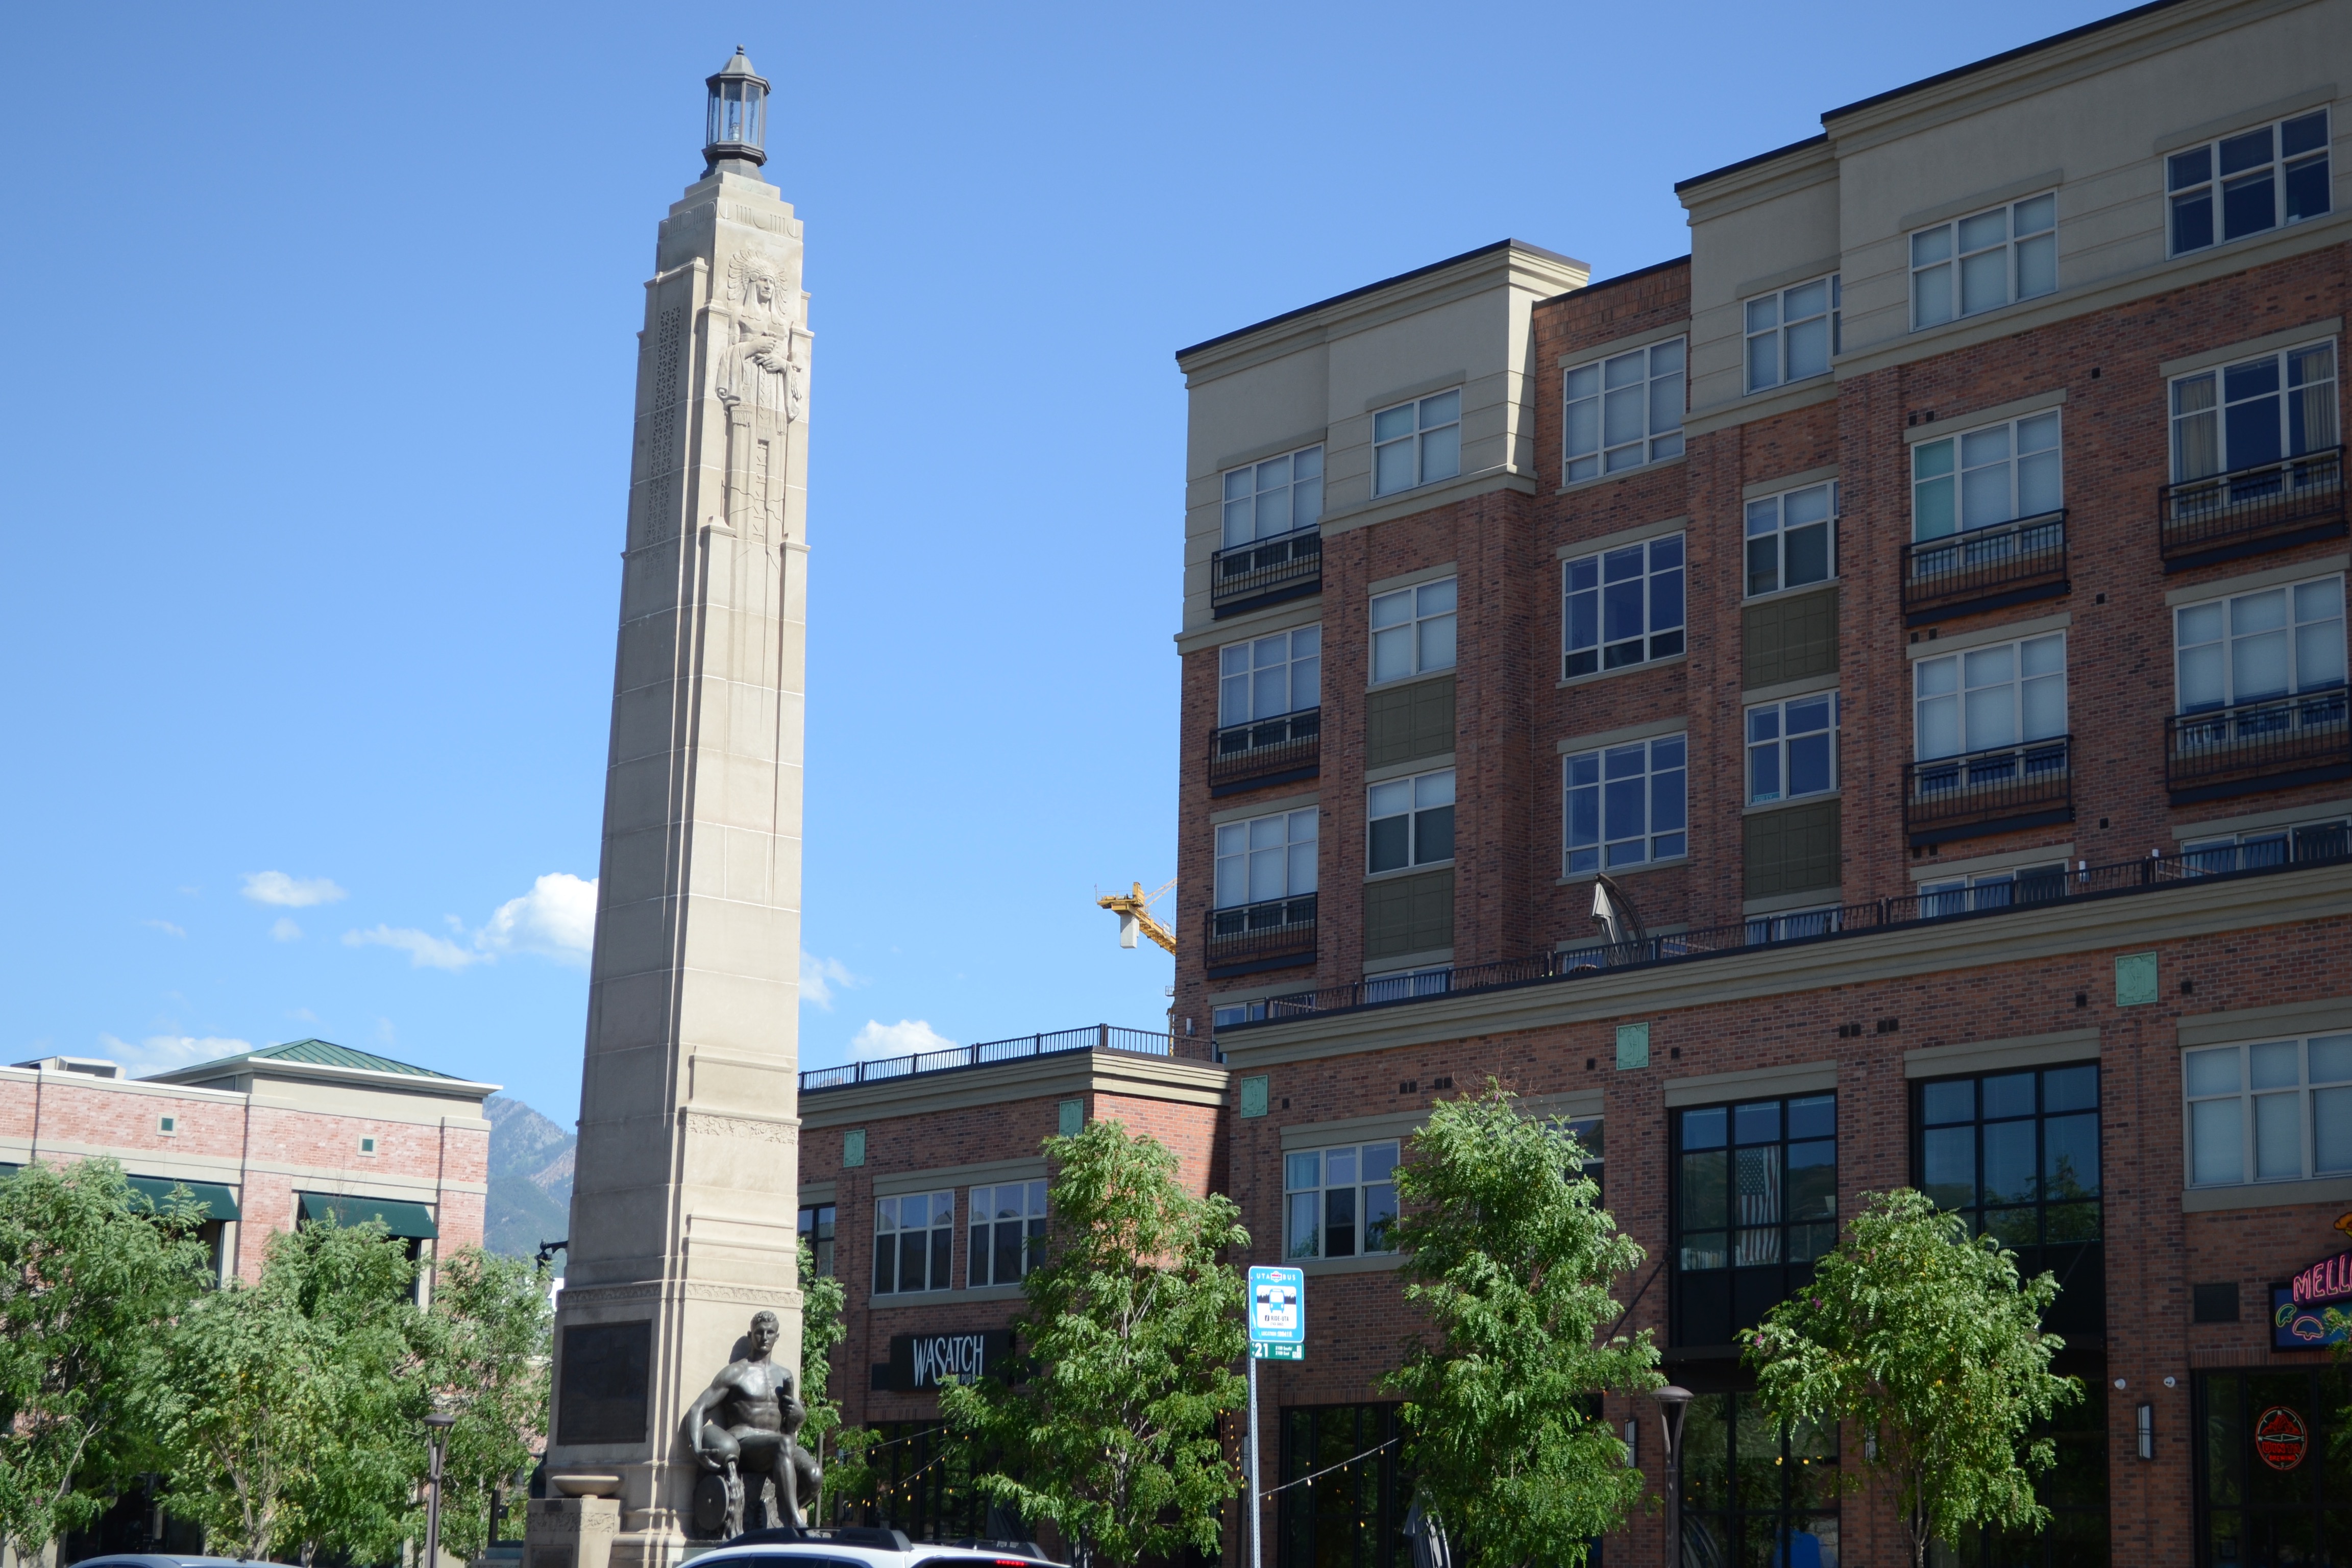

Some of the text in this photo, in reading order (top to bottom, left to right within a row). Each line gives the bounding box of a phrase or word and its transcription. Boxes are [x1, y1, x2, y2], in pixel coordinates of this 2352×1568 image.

[2293, 1255, 2352, 1302] MELL
[913, 1335, 984, 1386] WASATCH
[1255, 1343, 1268, 1357] 21
[2262, 1441, 2301, 1453] UINTA
